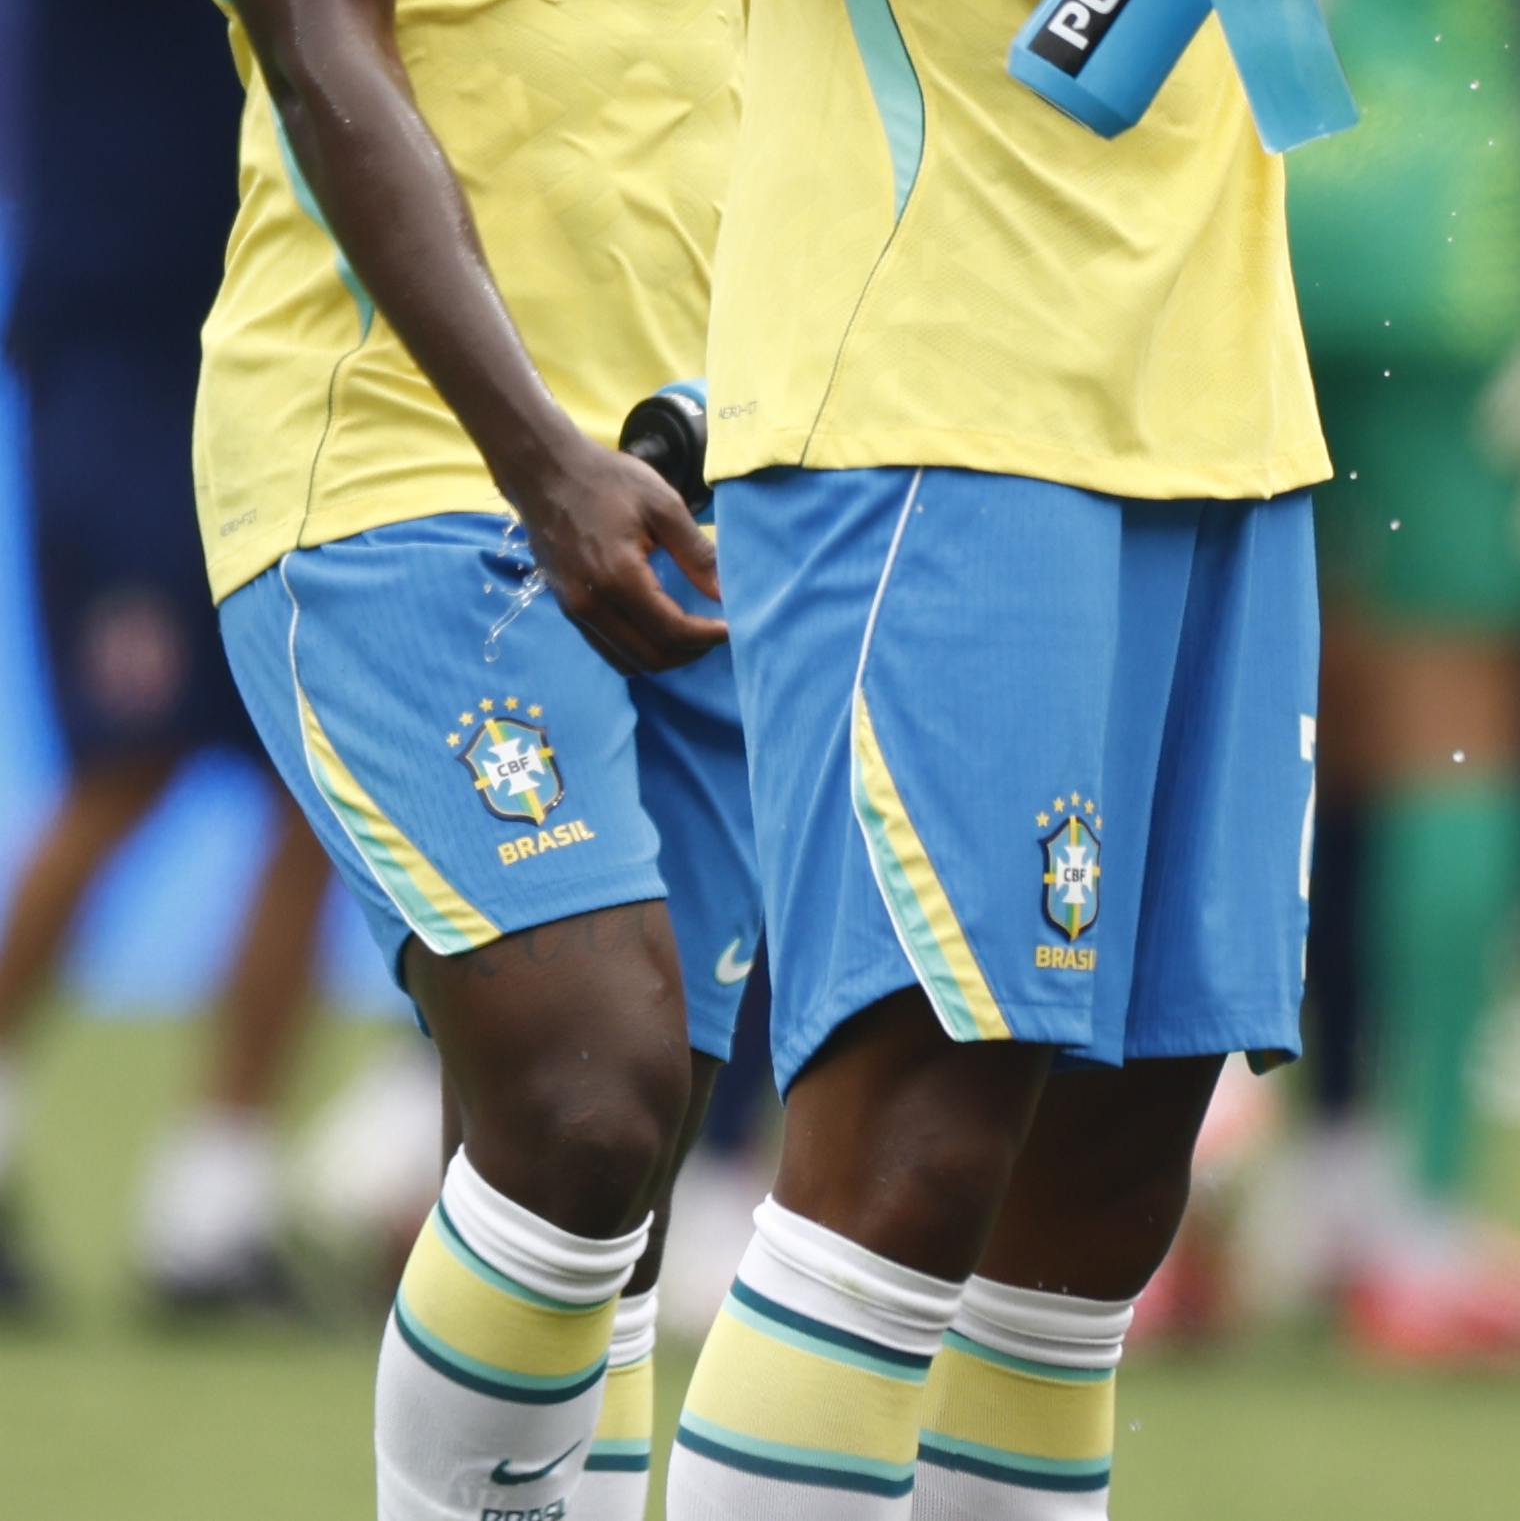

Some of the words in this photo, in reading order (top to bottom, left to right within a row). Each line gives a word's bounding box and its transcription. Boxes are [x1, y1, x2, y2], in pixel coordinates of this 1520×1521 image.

[496, 755, 531, 778] CBF
[497, 819, 596, 866] BRASIL
[1063, 867, 1087, 883] CBF
[1034, 944, 1097, 972] BRASI
